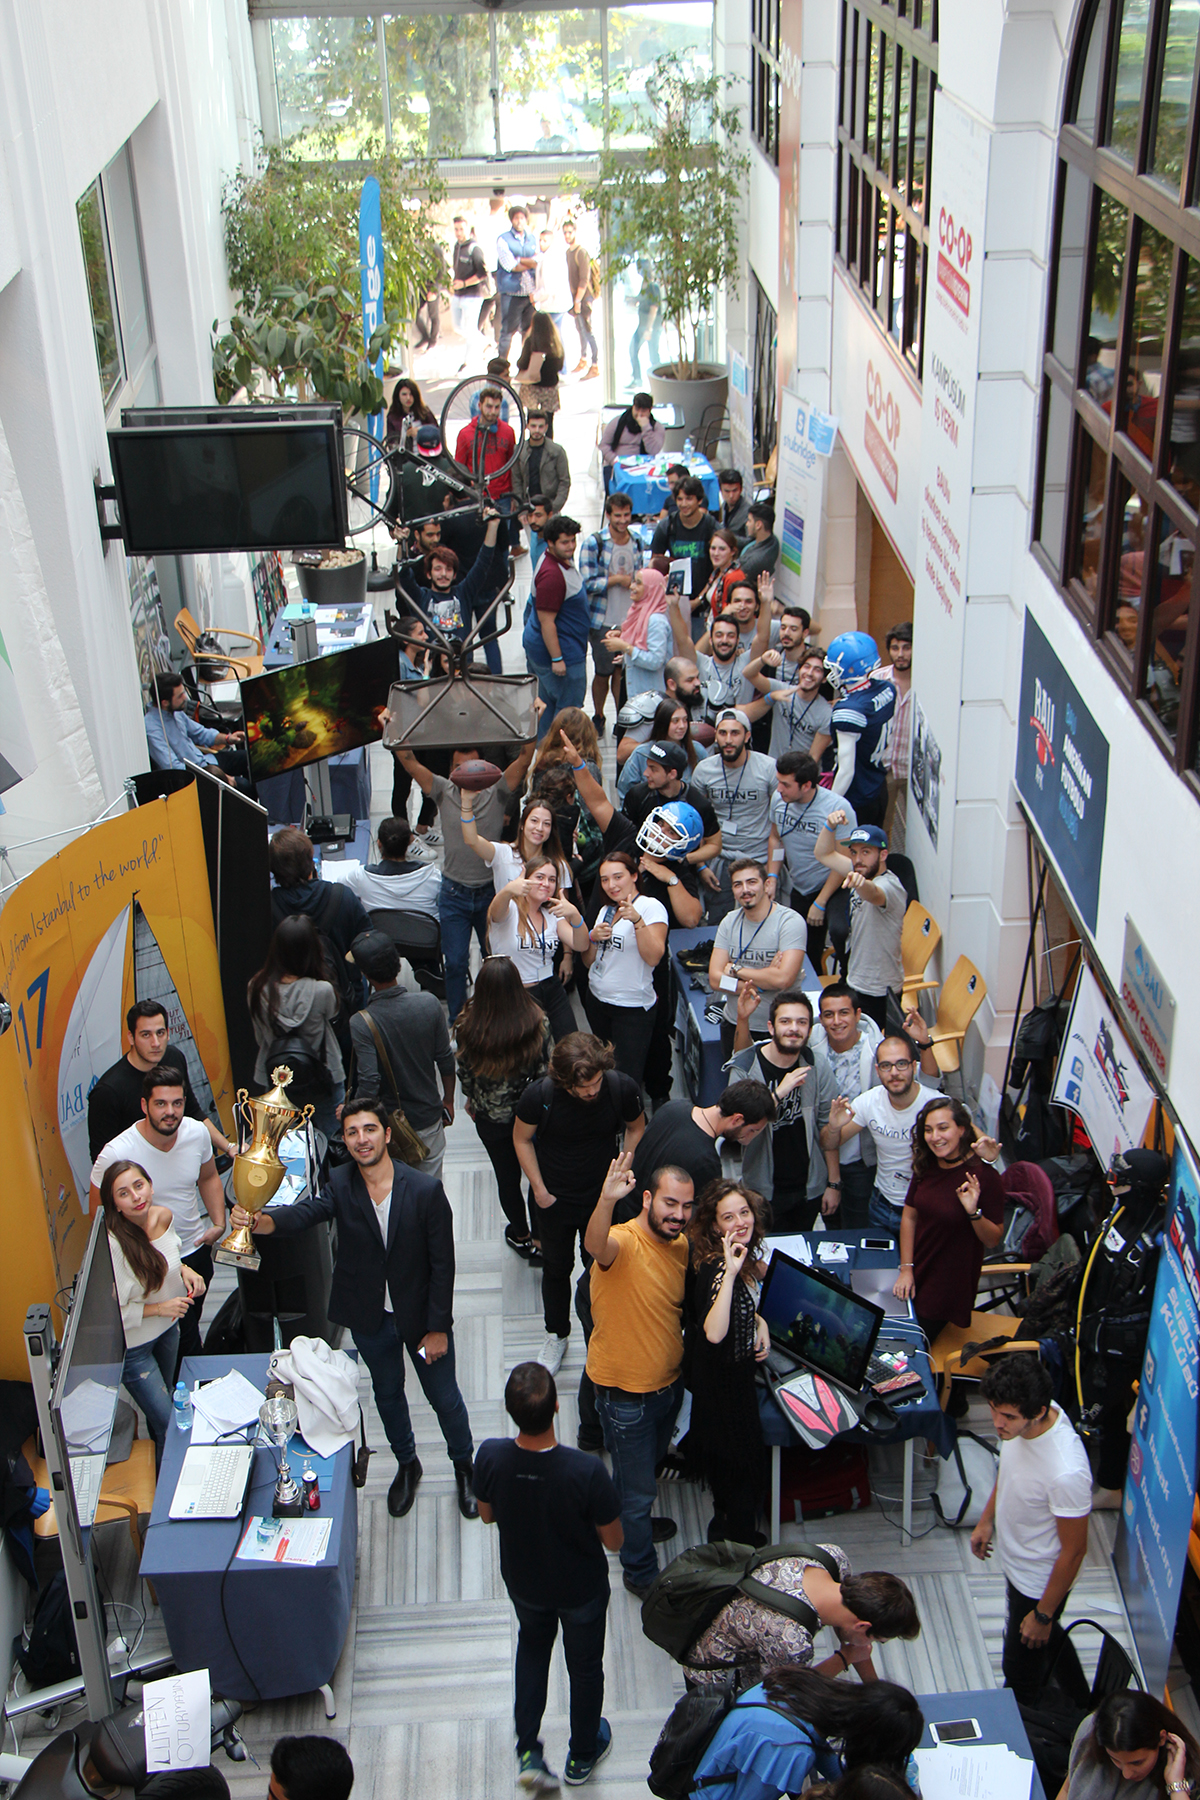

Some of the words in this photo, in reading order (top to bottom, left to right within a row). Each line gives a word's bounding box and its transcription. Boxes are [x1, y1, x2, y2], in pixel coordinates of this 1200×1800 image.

[939, 206, 973, 274] CO-OP
[866, 358, 901, 451] CO-OP
[1033, 676, 1056, 744] BAU
[710, 788, 758, 802] LIONS
[30, 881, 77, 938] Istanbul
[77, 884, 91, 902] to
[93, 860, 118, 890] the
[1143, 961, 1164, 1010] BAU
[1121, 982, 1141, 1024] COPY
[1139, 1016, 1167, 1076] CENTER
[868, 1118, 900, 1139] Calvin
[1148, 1432, 1170, 1501] busak
[1141, 1475, 1174, 1589] busak.org
